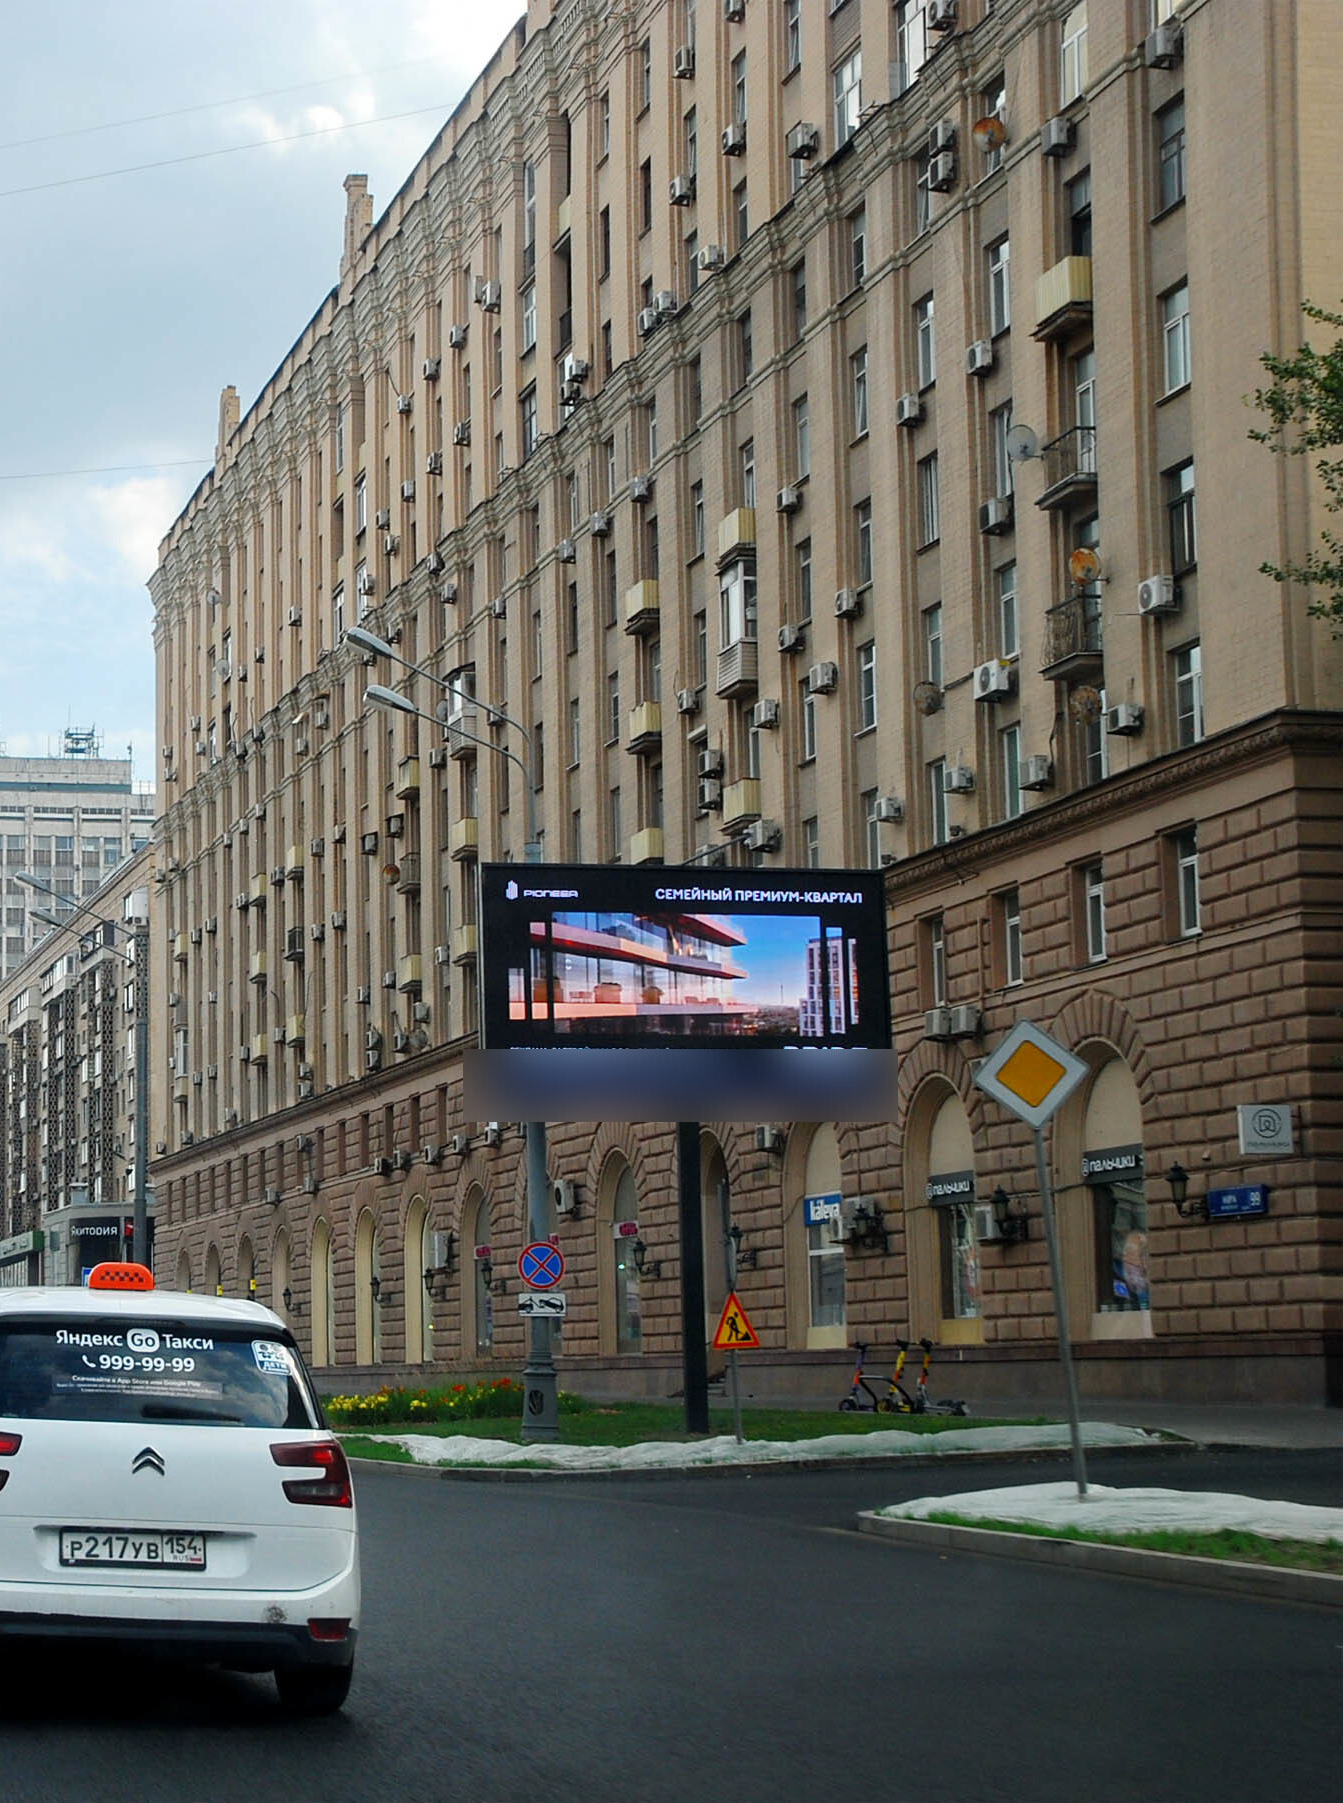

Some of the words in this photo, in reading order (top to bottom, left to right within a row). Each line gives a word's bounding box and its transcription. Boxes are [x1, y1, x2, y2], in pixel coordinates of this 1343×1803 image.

[523, 889, 579, 898] PIONEER
[655, 887, 732, 901] СЕМЕЙНЫЙ
[734, 889, 863, 904] ПРЕМИУМ-КВАРТАЛ
[71, 1225, 118, 1237] Якитория
[55, 1329, 124, 1347] Яндекс
[131, 1332, 157, 1347] Go
[162, 1333, 214, 1350] Такси
[98, 1354, 196, 1373] 999-99-99
[164, 1536, 198, 1555] 154
